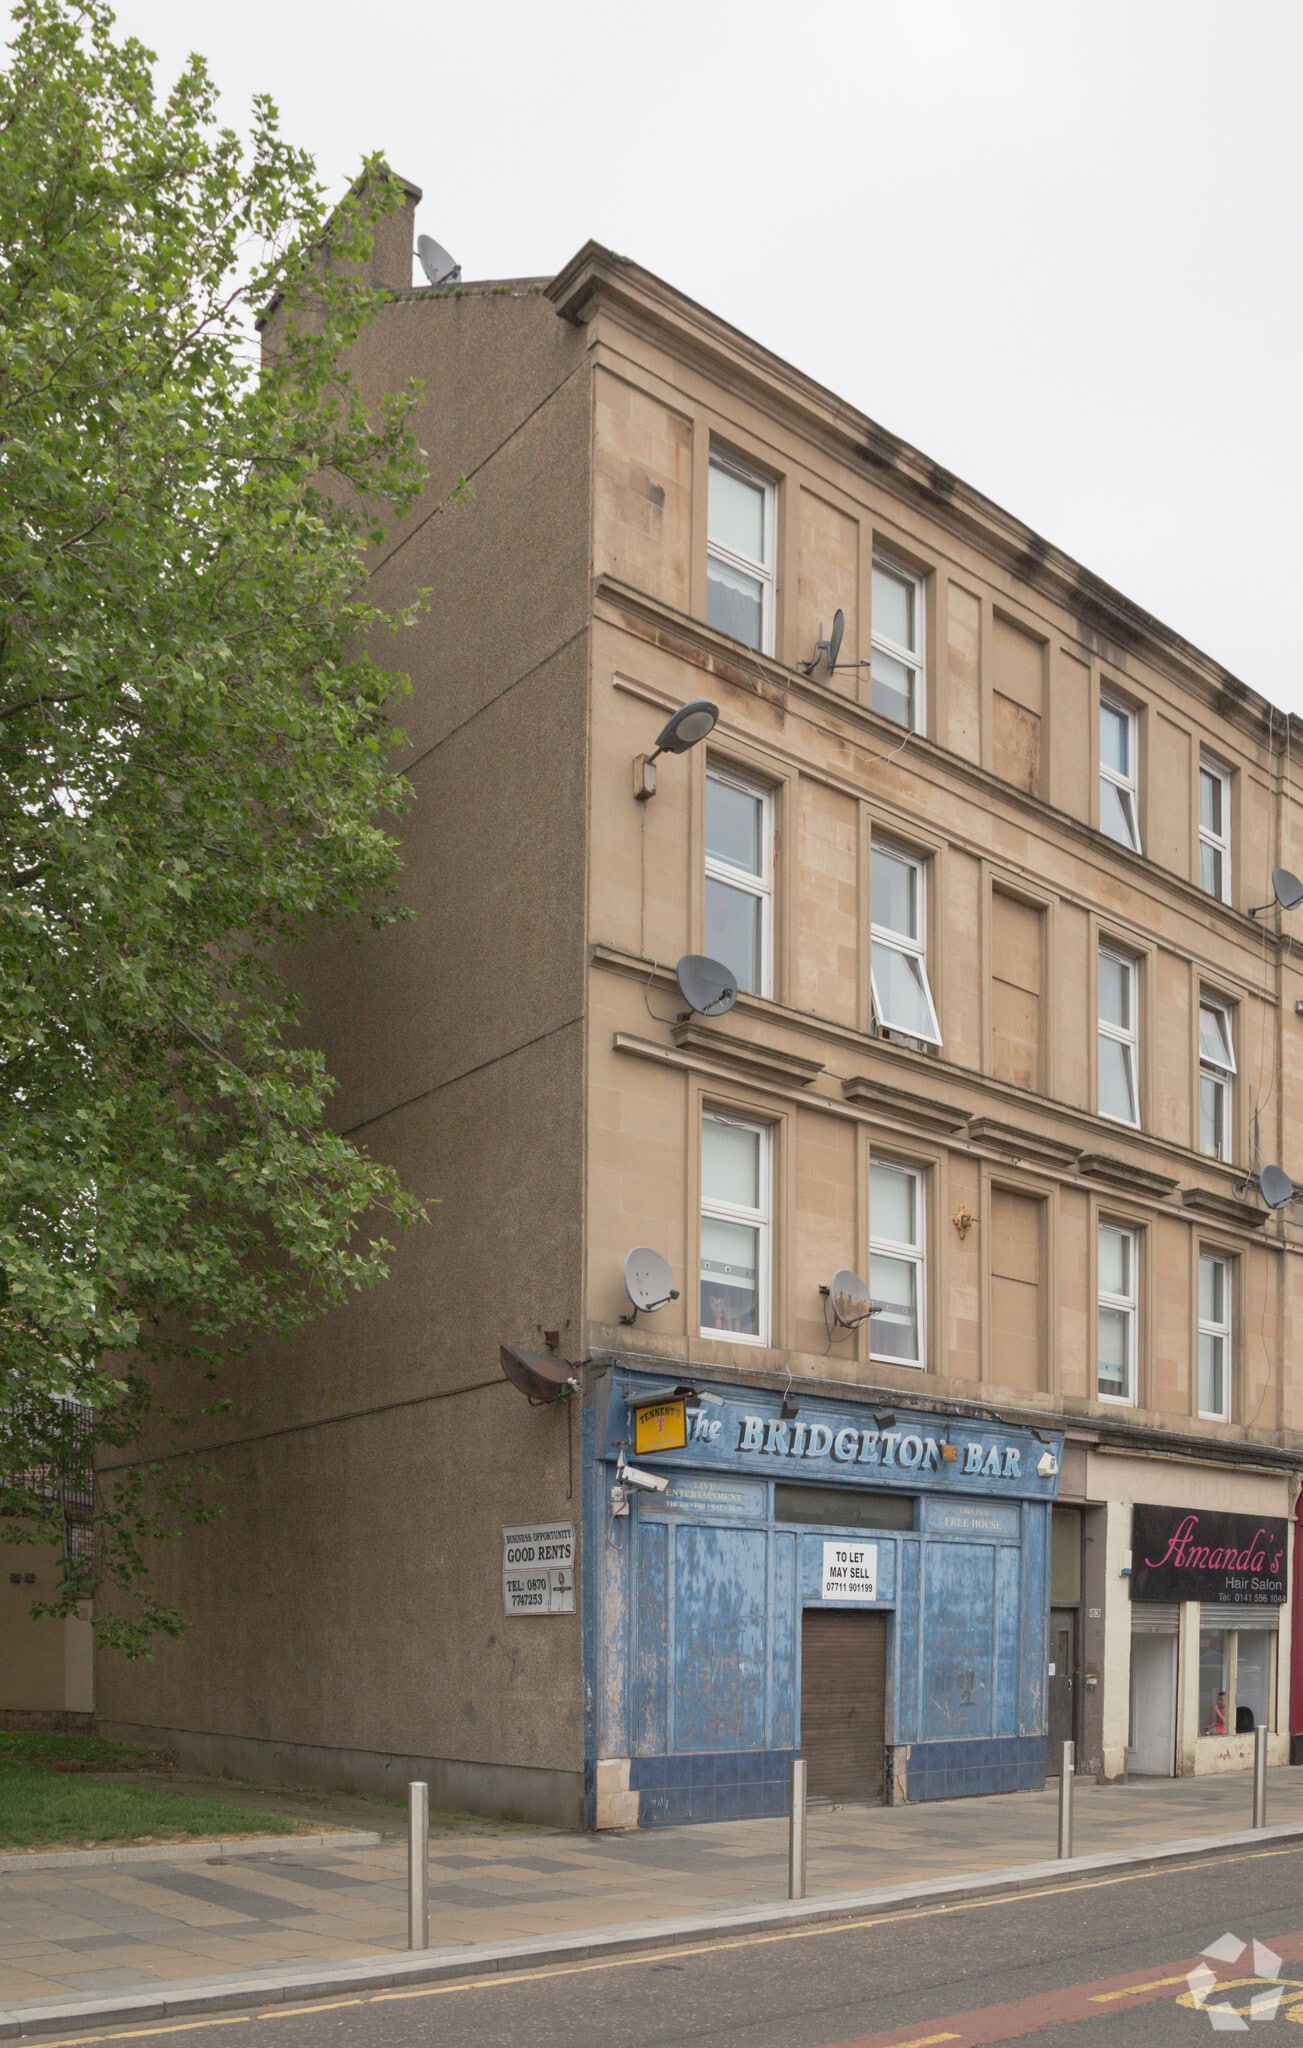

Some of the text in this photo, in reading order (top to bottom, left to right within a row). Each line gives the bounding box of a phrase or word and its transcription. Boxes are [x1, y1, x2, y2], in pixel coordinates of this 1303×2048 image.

[640, 1406, 681, 1424] TENNENT'S
[738, 1415, 945, 1471] BRIDGETON
[963, 1442, 1022, 1478] BAR
[693, 1480, 716, 1490] LIVE
[666, 1488, 742, 1502] ENTERTAINMENT
[944, 1517, 1002, 1530] FREE HOUSE
[506, 1529, 571, 1544] BUSINESS OPPORTUNITY
[1144, 1515, 1283, 1574] Amanda's
[507, 1543, 571, 1563] GOOD RENTS
[836, 1551, 864, 1563] TO LET
[829, 1566, 870, 1579] MAY SELL
[506, 1578, 547, 1592] TEL: 0870
[826, 1582, 873, 1593] 07711 901199
[1225, 1576, 1282, 1591] Hair Salon
[1235, 1593, 1252, 1602] 0141
